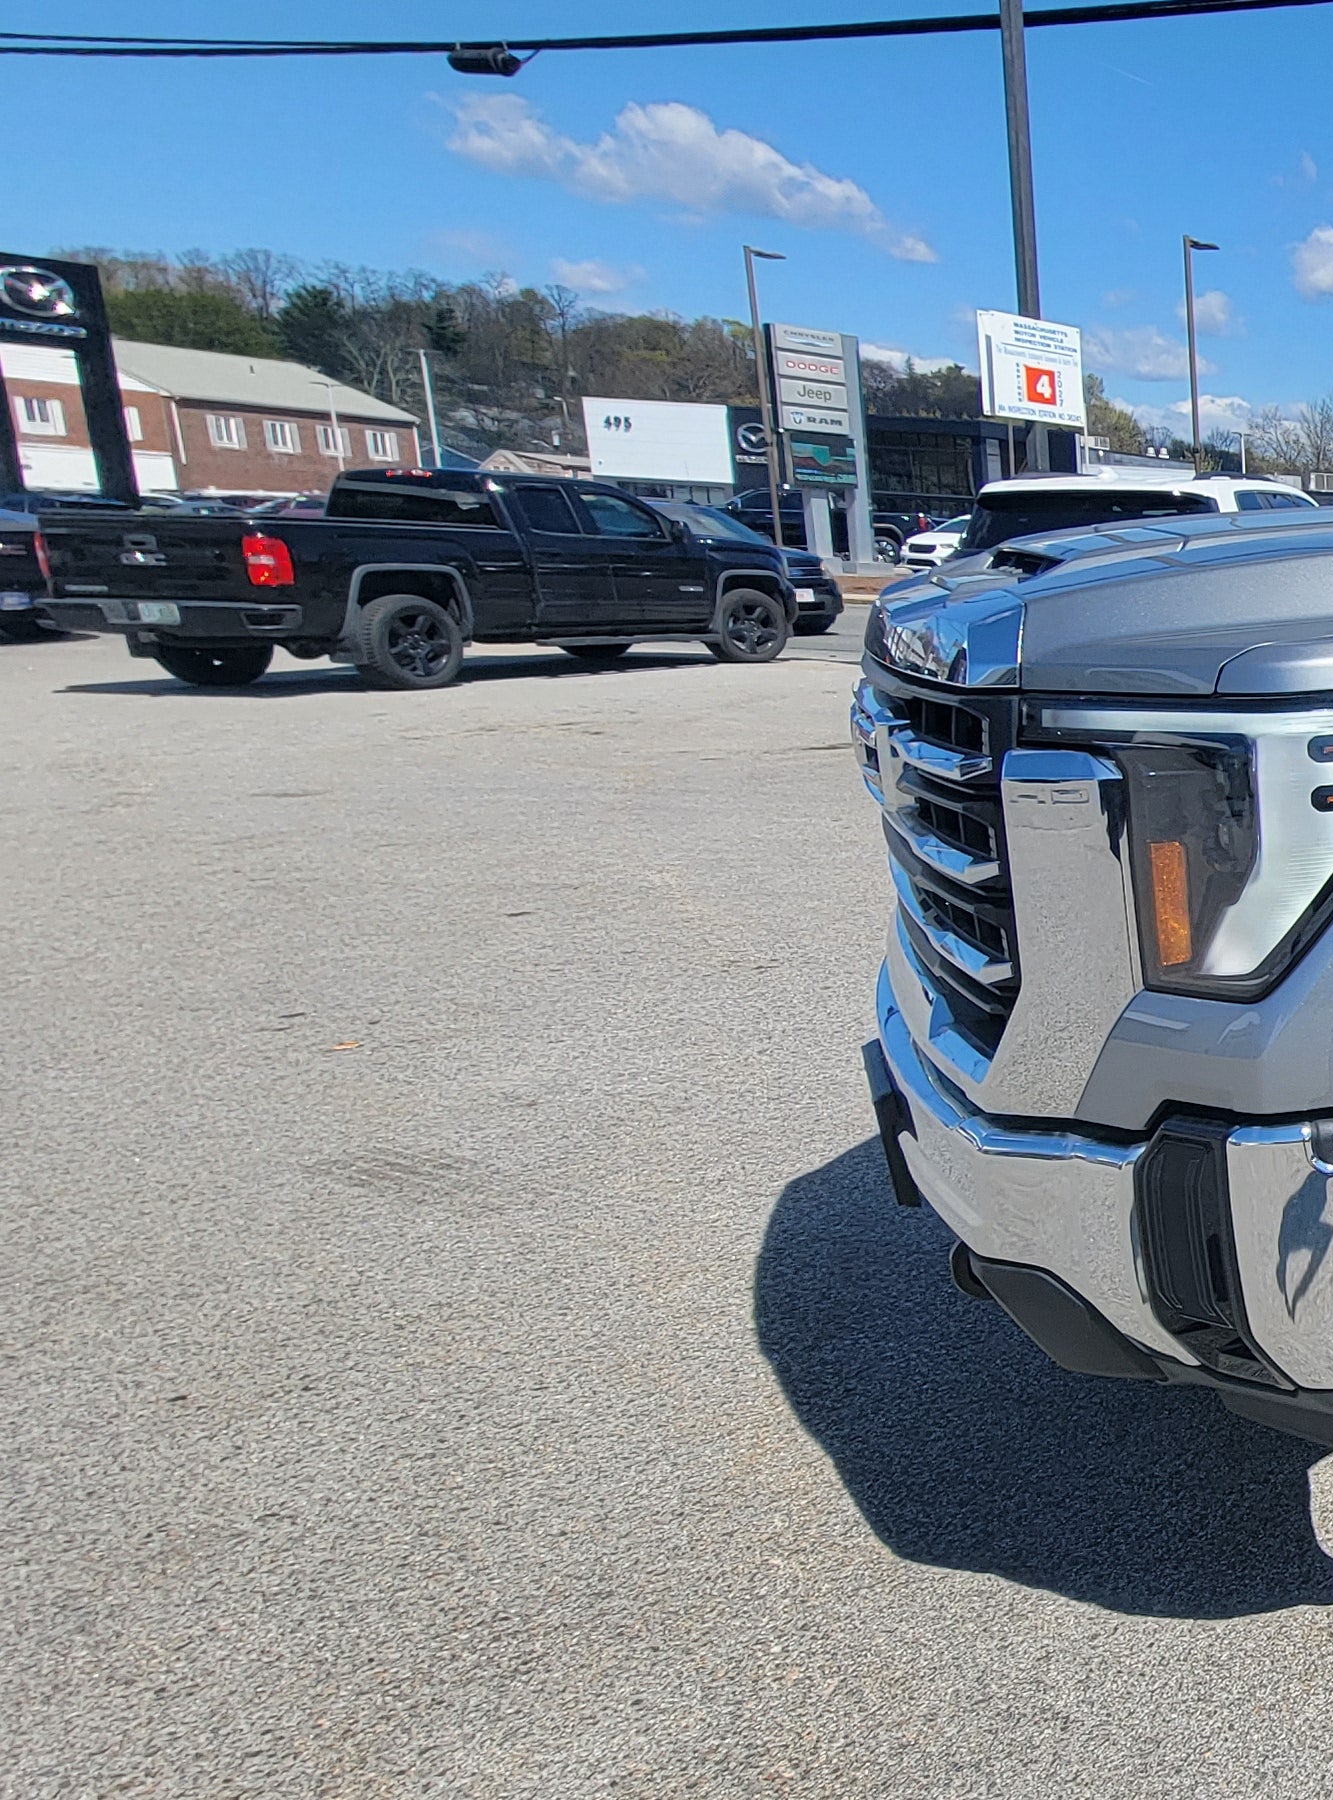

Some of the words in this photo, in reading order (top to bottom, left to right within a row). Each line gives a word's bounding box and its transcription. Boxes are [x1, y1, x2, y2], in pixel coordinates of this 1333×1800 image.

[784, 330, 834, 341] CHRYSLER
[1013, 321, 1068, 338] MASSACHUSETTS
[1014, 329, 1036, 338] MOTOR
[1039, 334, 1064, 344] VEHICLE
[1014, 337, 1051, 349] INSPECTION
[1054, 344, 1077, 353] STATION
[786, 361, 839, 374] DODGE
[797, 384, 832, 402] Jeep
[1036, 374, 1053, 399] 4
[603, 415, 632, 432] 495
[806, 416, 843, 426] RAM
